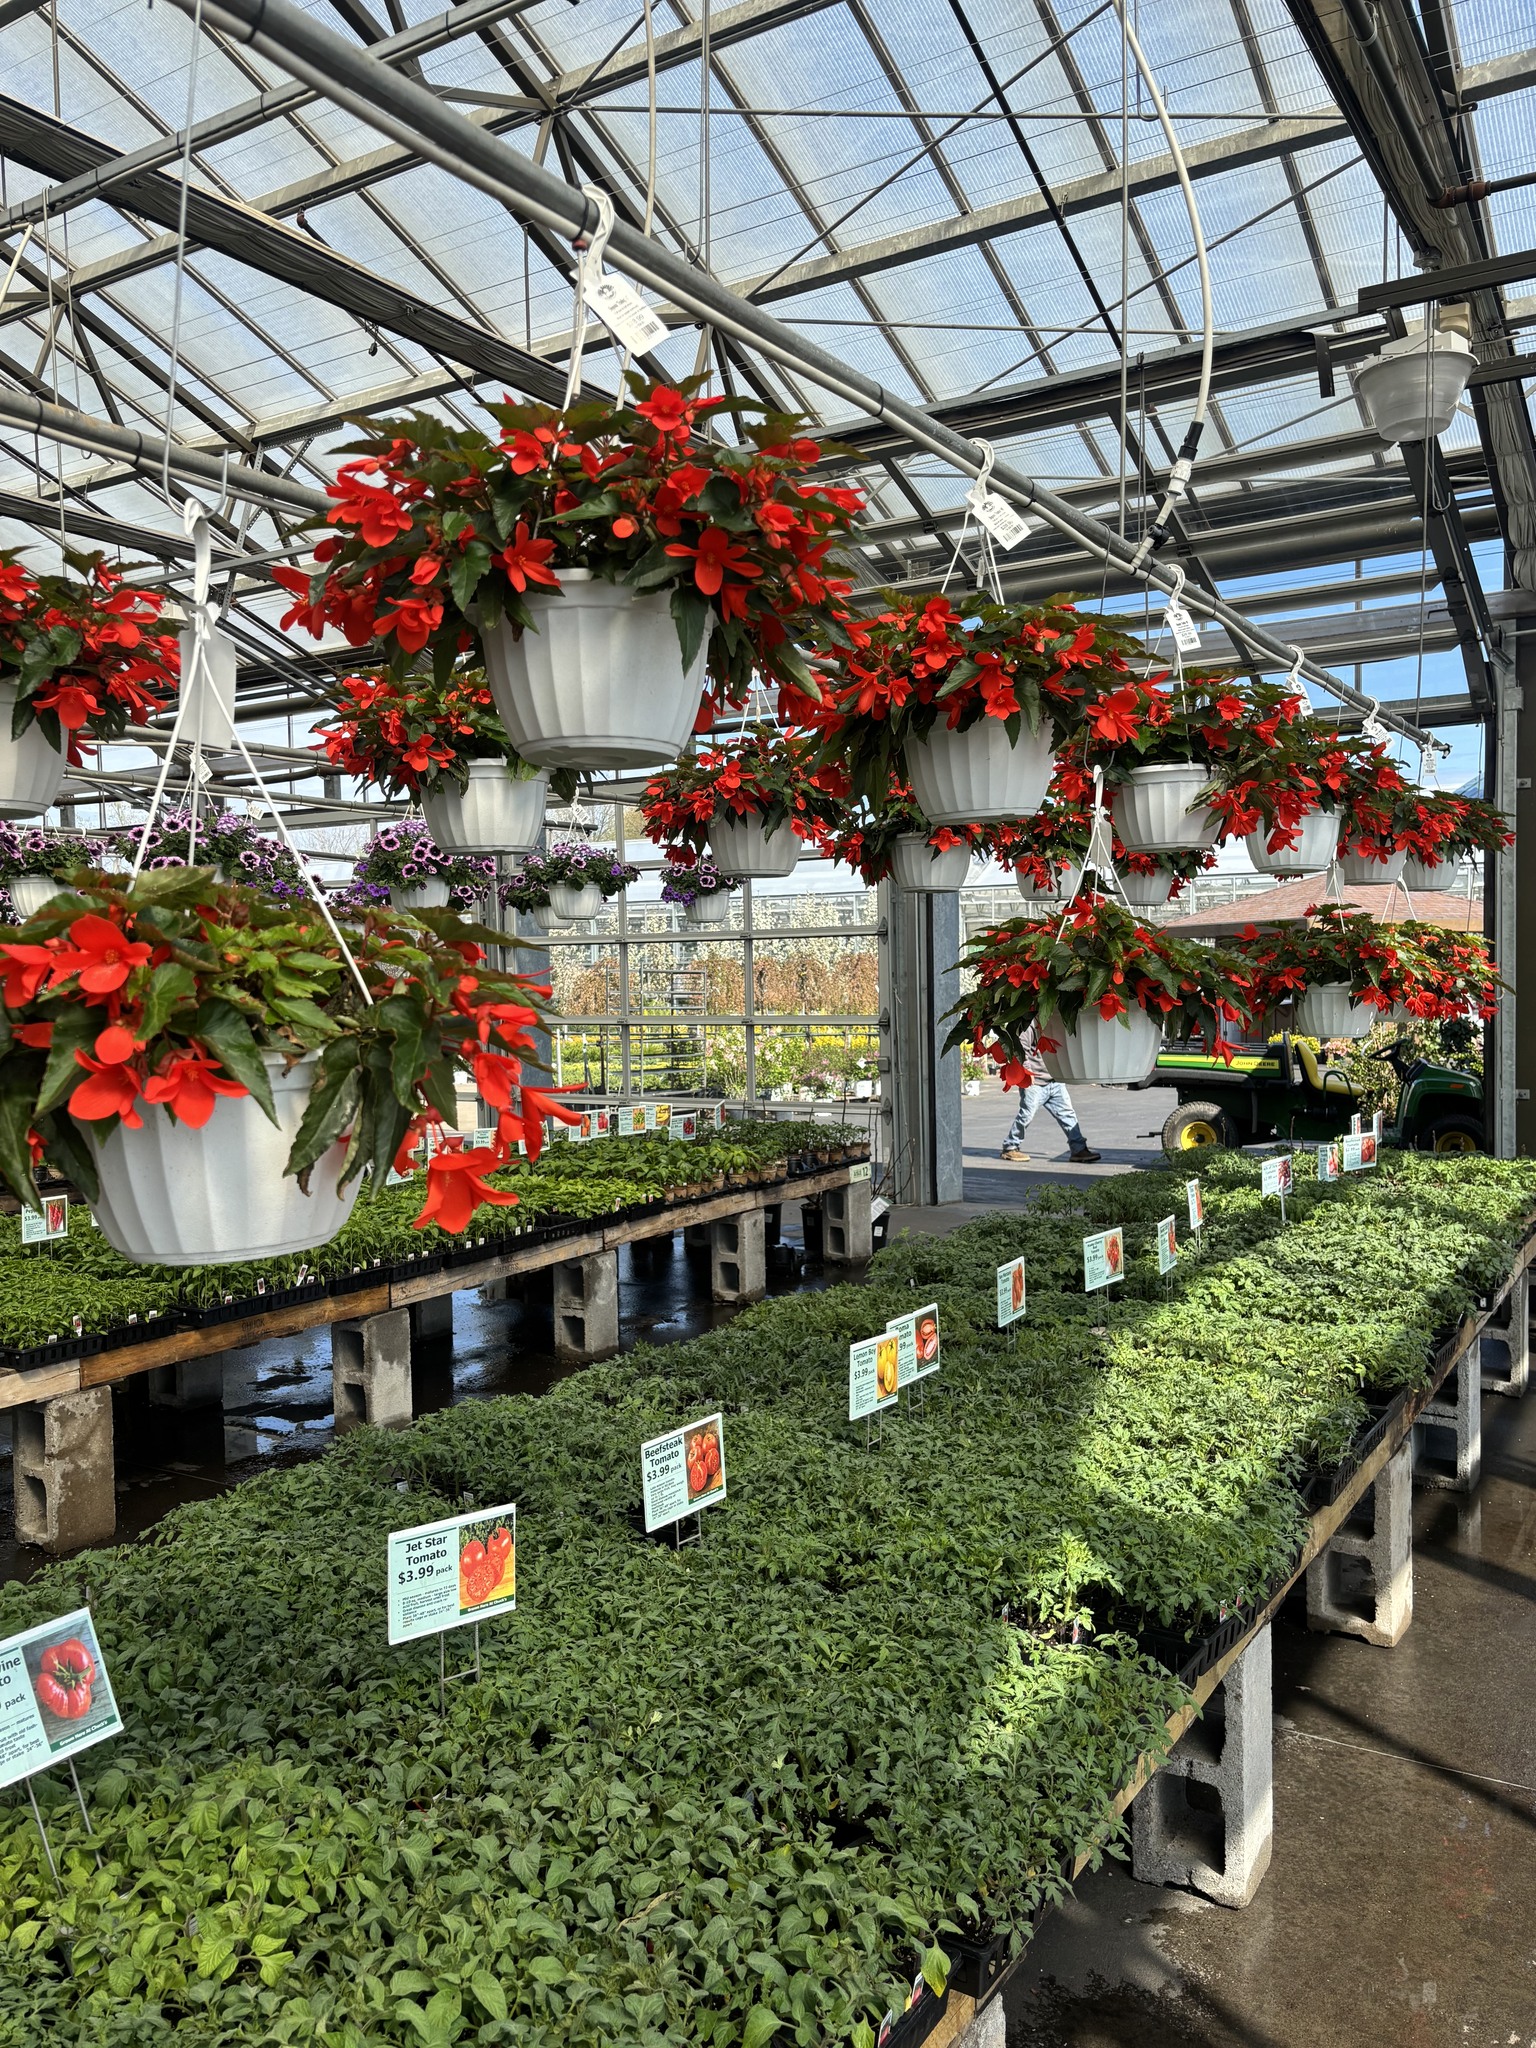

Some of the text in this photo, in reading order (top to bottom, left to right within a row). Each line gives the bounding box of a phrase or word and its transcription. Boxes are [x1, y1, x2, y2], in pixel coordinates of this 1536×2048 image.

[895, 1323, 909, 1333] oma
[899, 1330, 912, 1340] mato
[898, 1342, 907, 1351] .99
[853, 1351, 868, 1361] Lemon
[857, 1357, 873, 1367] Tomato
[854, 1367, 869, 1380] $3.99
[645, 1436, 683, 1459] Beefsteak
[650, 1450, 679, 1468] Tomato
[646, 1463, 682, 1483] $3.99 pack
[405, 1535, 448, 1553] Jet Star
[406, 1549, 447, 1566] Tomato
[398, 1564, 453, 1585] $3.99 pack
[5, 1693, 26, 1710] pack
